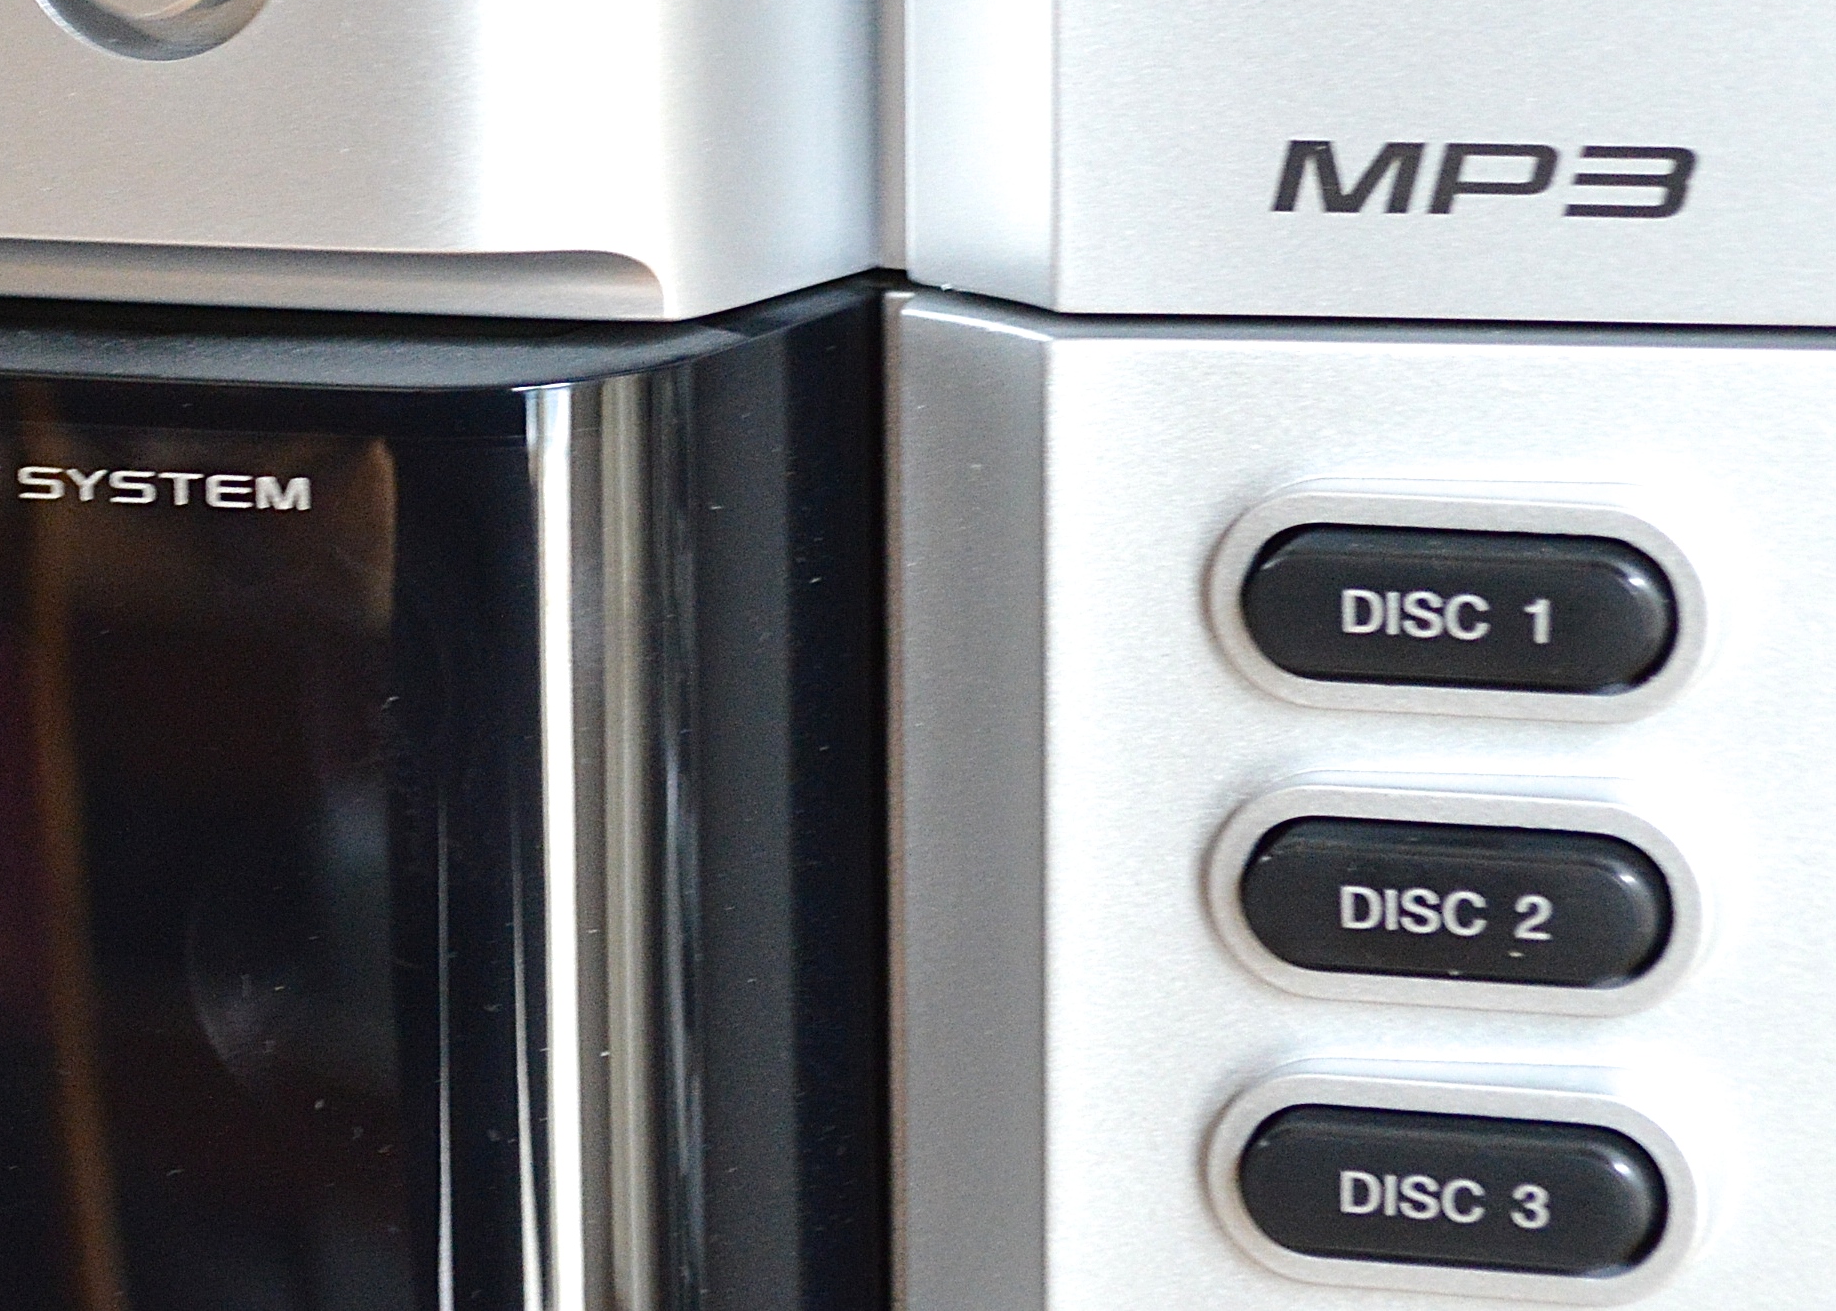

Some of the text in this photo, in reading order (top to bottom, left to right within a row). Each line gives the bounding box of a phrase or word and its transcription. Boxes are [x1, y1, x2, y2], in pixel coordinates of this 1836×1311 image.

[1270, 139, 1698, 219] MP3
[17, 465, 313, 512] SYSTEM
[1341, 588, 1553, 645] DISC 1
[1339, 884, 1553, 942] DISC 2
[1338, 1169, 1551, 1230] DISC 3
